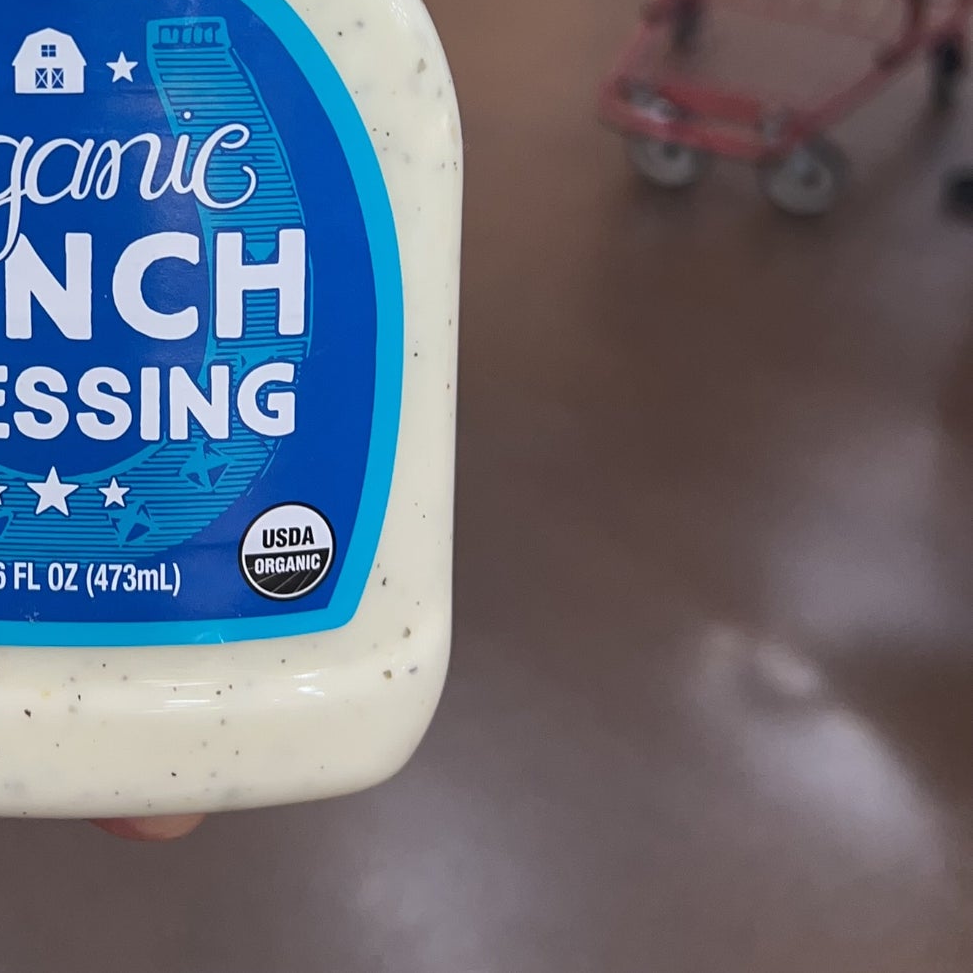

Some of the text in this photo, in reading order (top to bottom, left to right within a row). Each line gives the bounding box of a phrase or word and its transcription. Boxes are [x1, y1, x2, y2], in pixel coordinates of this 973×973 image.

[262, 526, 315, 549] USDA
[254, 553, 321, 575] ORGANIC
[14, 560, 42, 591] FL
[47, 560, 78, 592] OZ
[86, 560, 182, 597] (473mL)
